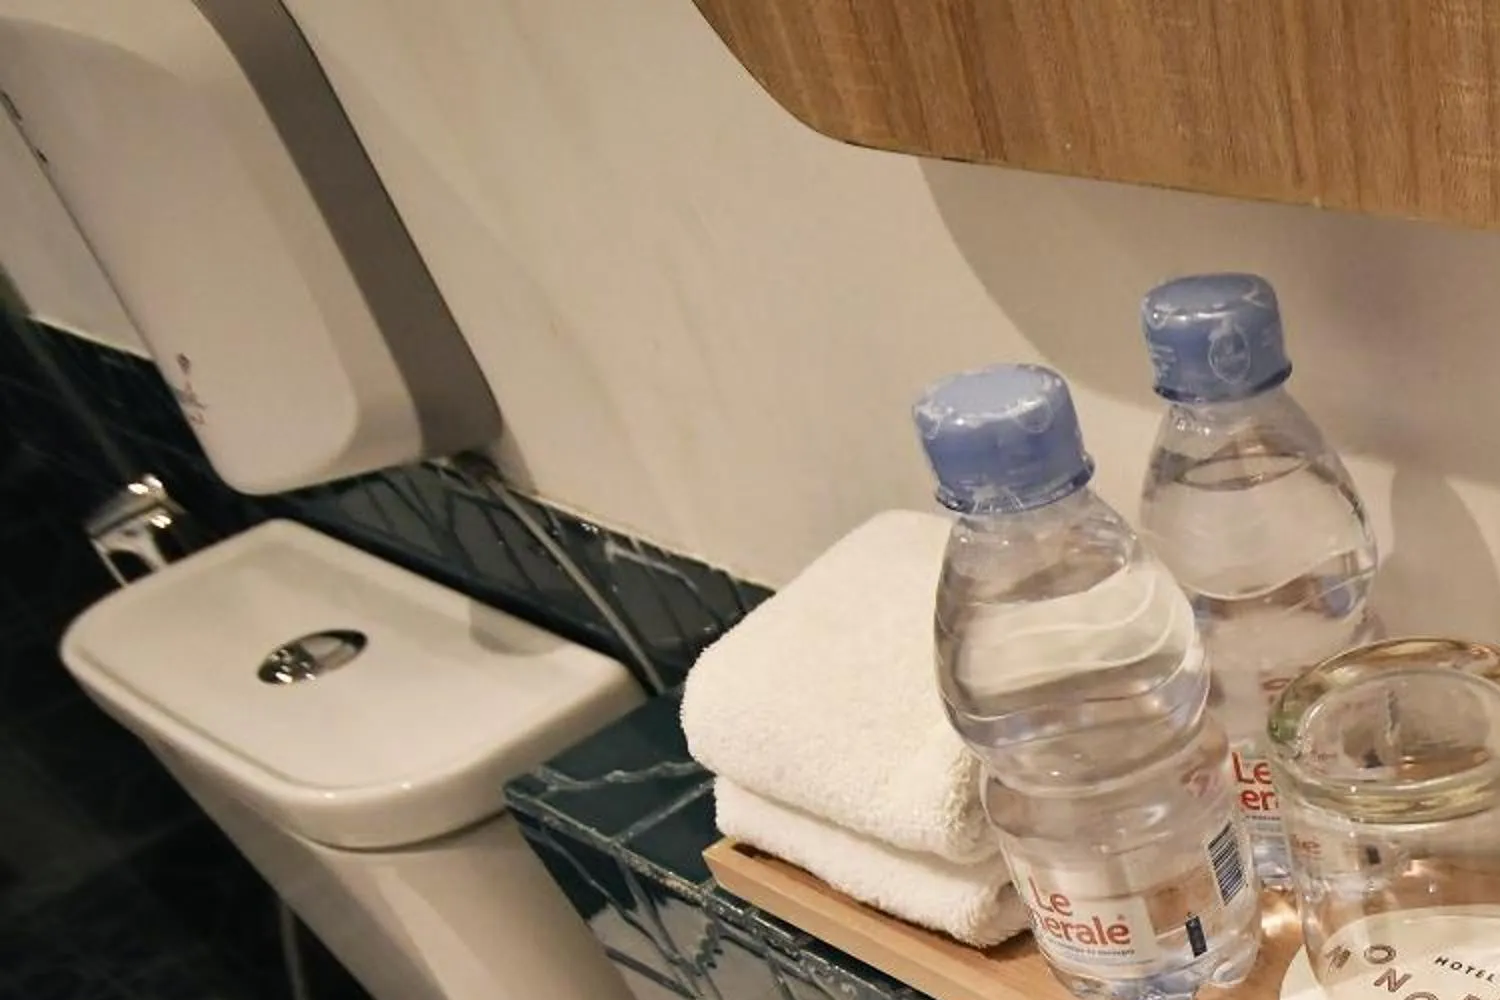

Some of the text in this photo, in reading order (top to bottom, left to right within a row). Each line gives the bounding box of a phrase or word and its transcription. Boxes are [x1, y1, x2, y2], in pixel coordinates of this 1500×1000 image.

[1231, 752, 1273, 785] Le
[1028, 877, 1073, 917] Le
[1434, 955, 1497, 983] HOTEL
